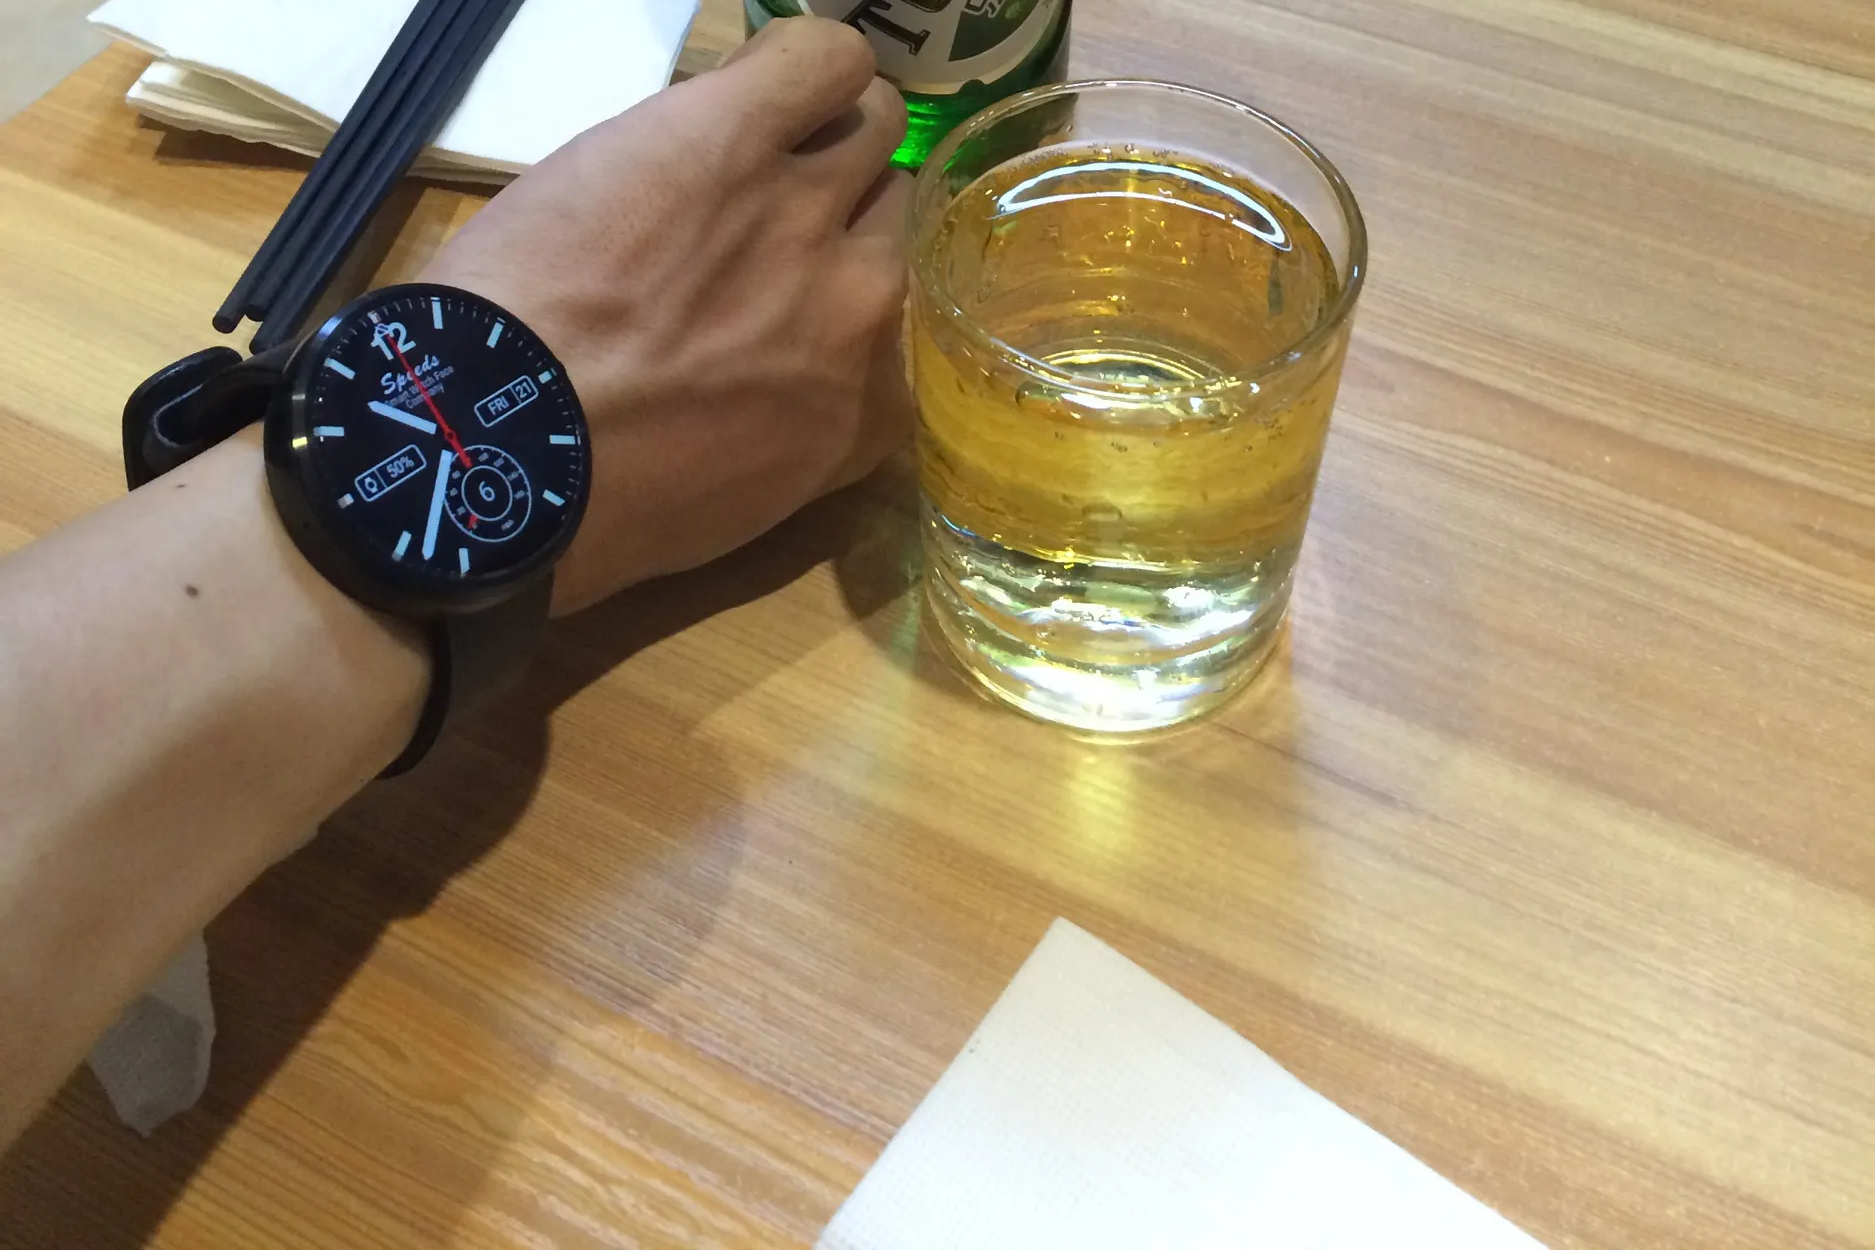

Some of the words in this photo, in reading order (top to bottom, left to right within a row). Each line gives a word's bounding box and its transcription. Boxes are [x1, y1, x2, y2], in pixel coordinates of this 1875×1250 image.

[371, 321, 417, 361] 12
[487, 395, 510, 416] FRI
[515, 381, 532, 399] 21
[386, 455, 415, 478] 50%
[479, 480, 496, 502] 6
